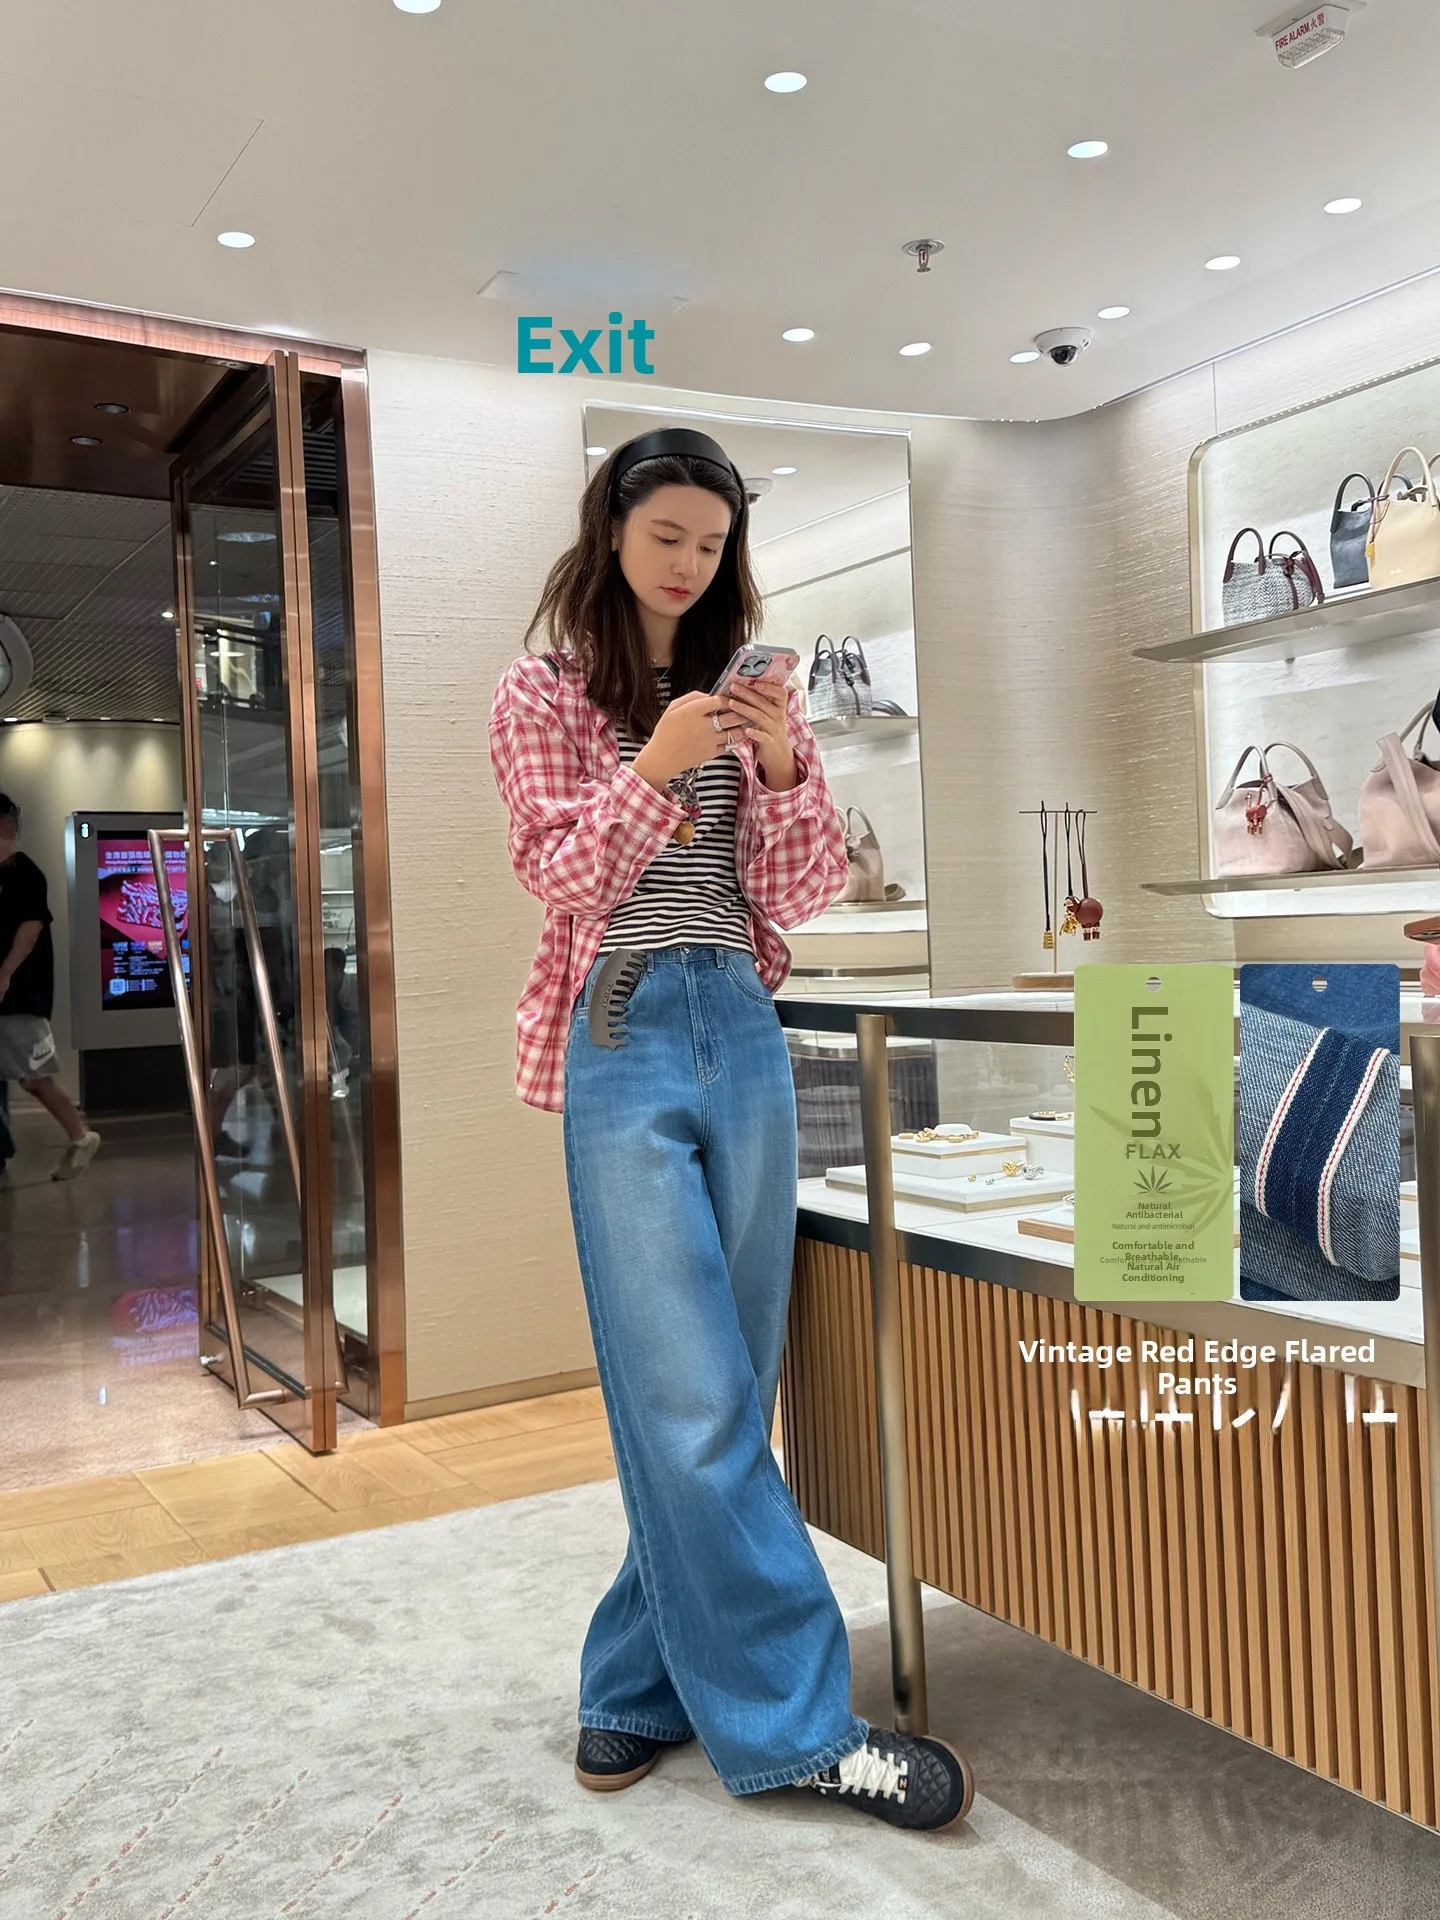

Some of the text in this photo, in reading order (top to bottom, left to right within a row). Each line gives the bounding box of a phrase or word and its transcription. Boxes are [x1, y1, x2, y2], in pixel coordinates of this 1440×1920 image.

[1275, 22, 1311, 51] FIRE ALARM
[1131, 1006, 1173, 1138] Linen
[1125, 1143, 1182, 1160] FLAX
[1137, 1202, 1172, 1210] Natural
[1125, 1210, 1184, 1219] Antibacterial
[1111, 1222, 1136, 1230] Natural
[1137, 1222, 1151, 1230] and
[1112, 1241, 1195, 1250] Comfortable and
[1127, 1262, 1181, 1271] Natural Air
[1122, 1273, 1185, 1283] Conditioning
